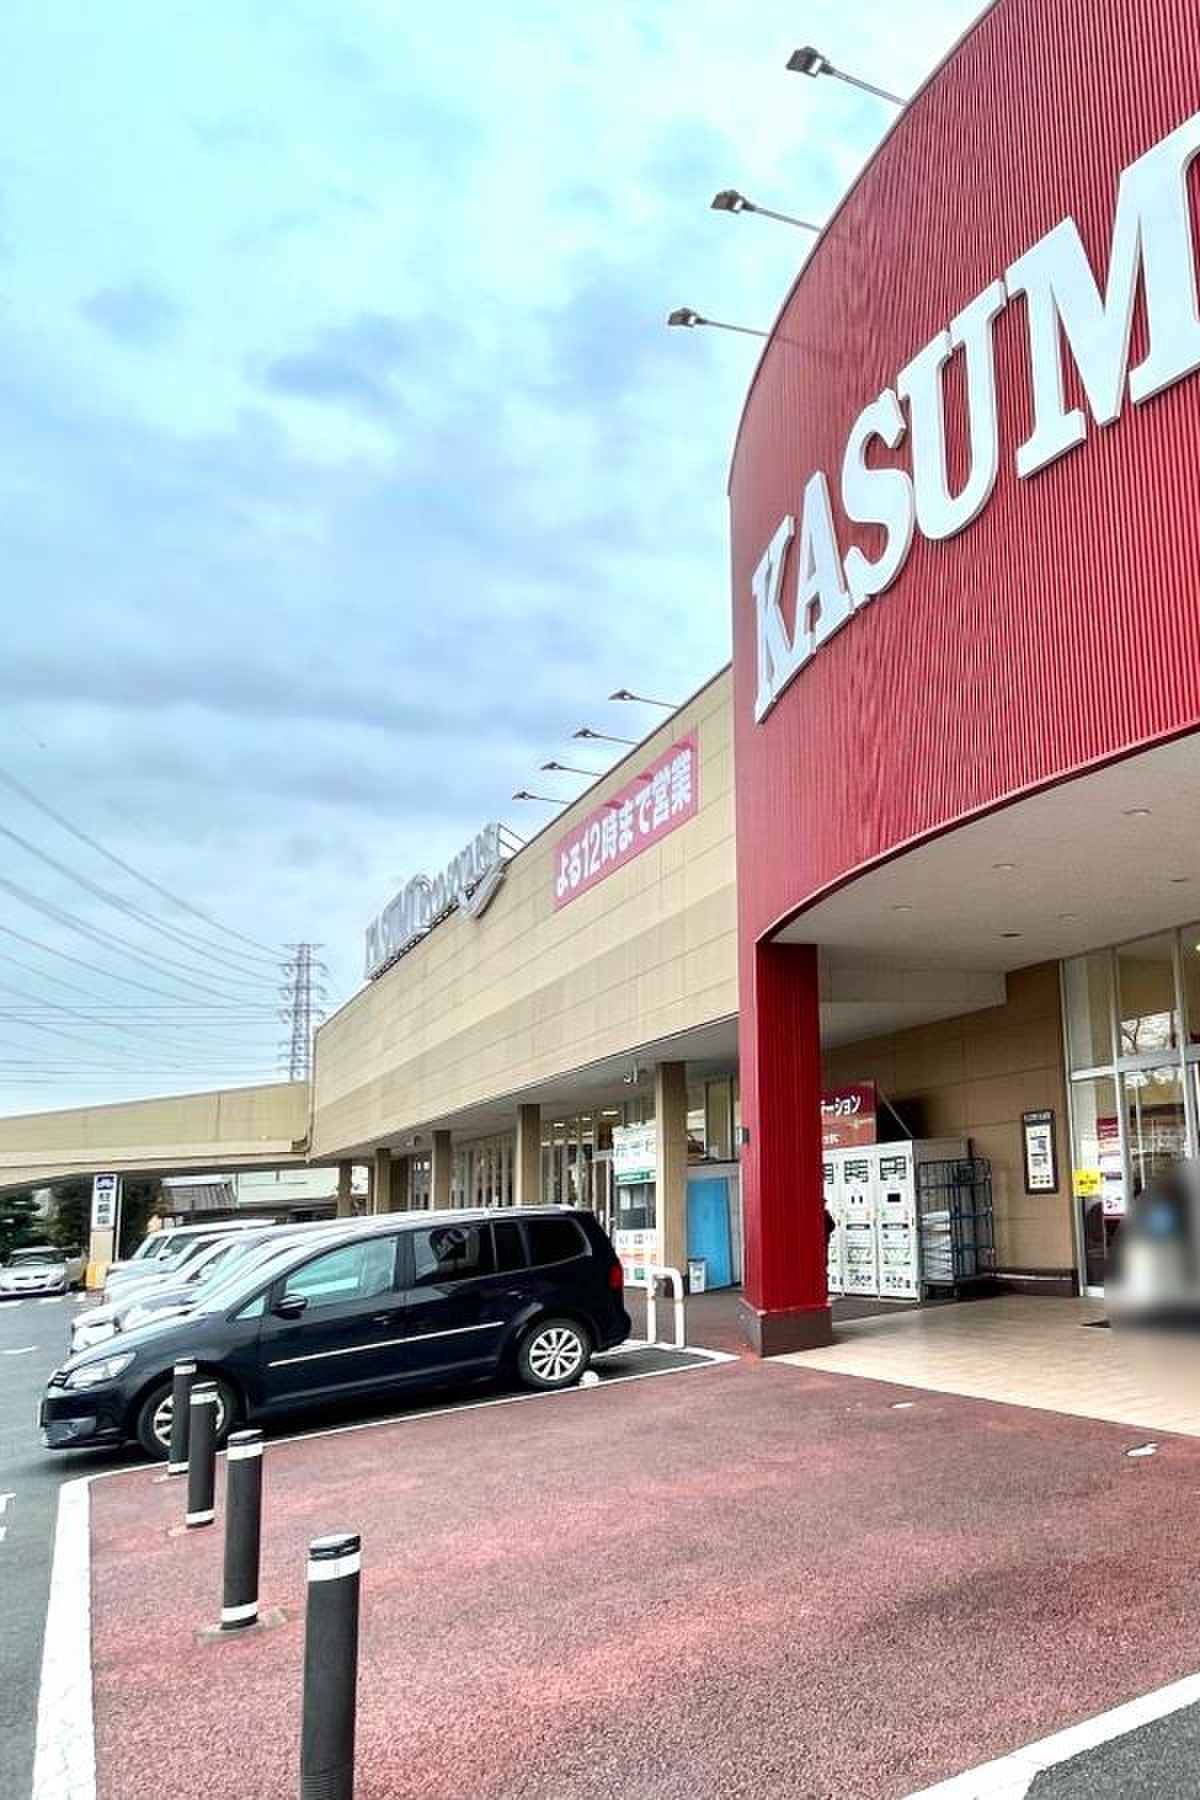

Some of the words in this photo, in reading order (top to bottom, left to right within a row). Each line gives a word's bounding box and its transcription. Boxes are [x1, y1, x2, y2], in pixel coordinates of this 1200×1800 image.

[557, 748, 692, 896] よる12時まで営業
[821, 1094, 862, 1116] ーション
